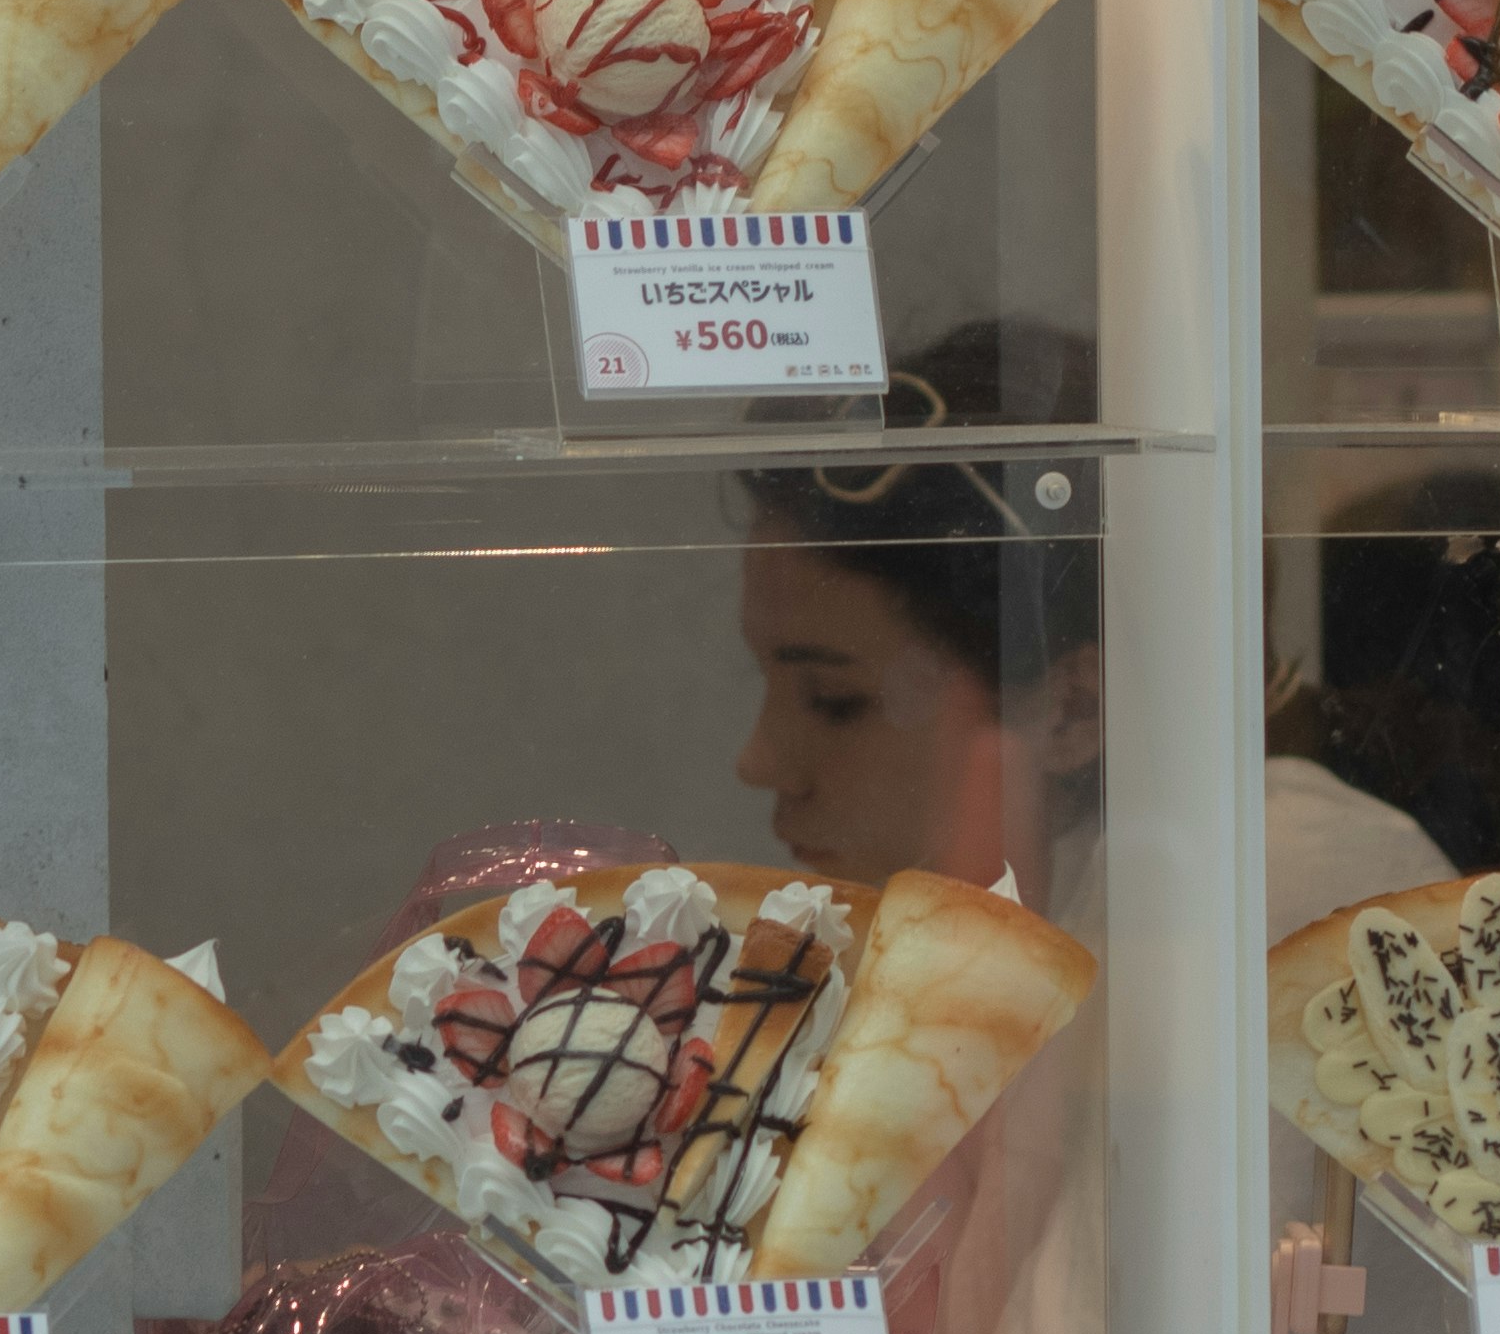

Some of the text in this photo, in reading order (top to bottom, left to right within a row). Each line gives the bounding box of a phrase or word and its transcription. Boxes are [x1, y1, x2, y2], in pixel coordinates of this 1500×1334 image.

[641, 280, 813, 305] いちごスペシャル
[676, 319, 767, 350] ¥560
[599, 357, 625, 374] 21
